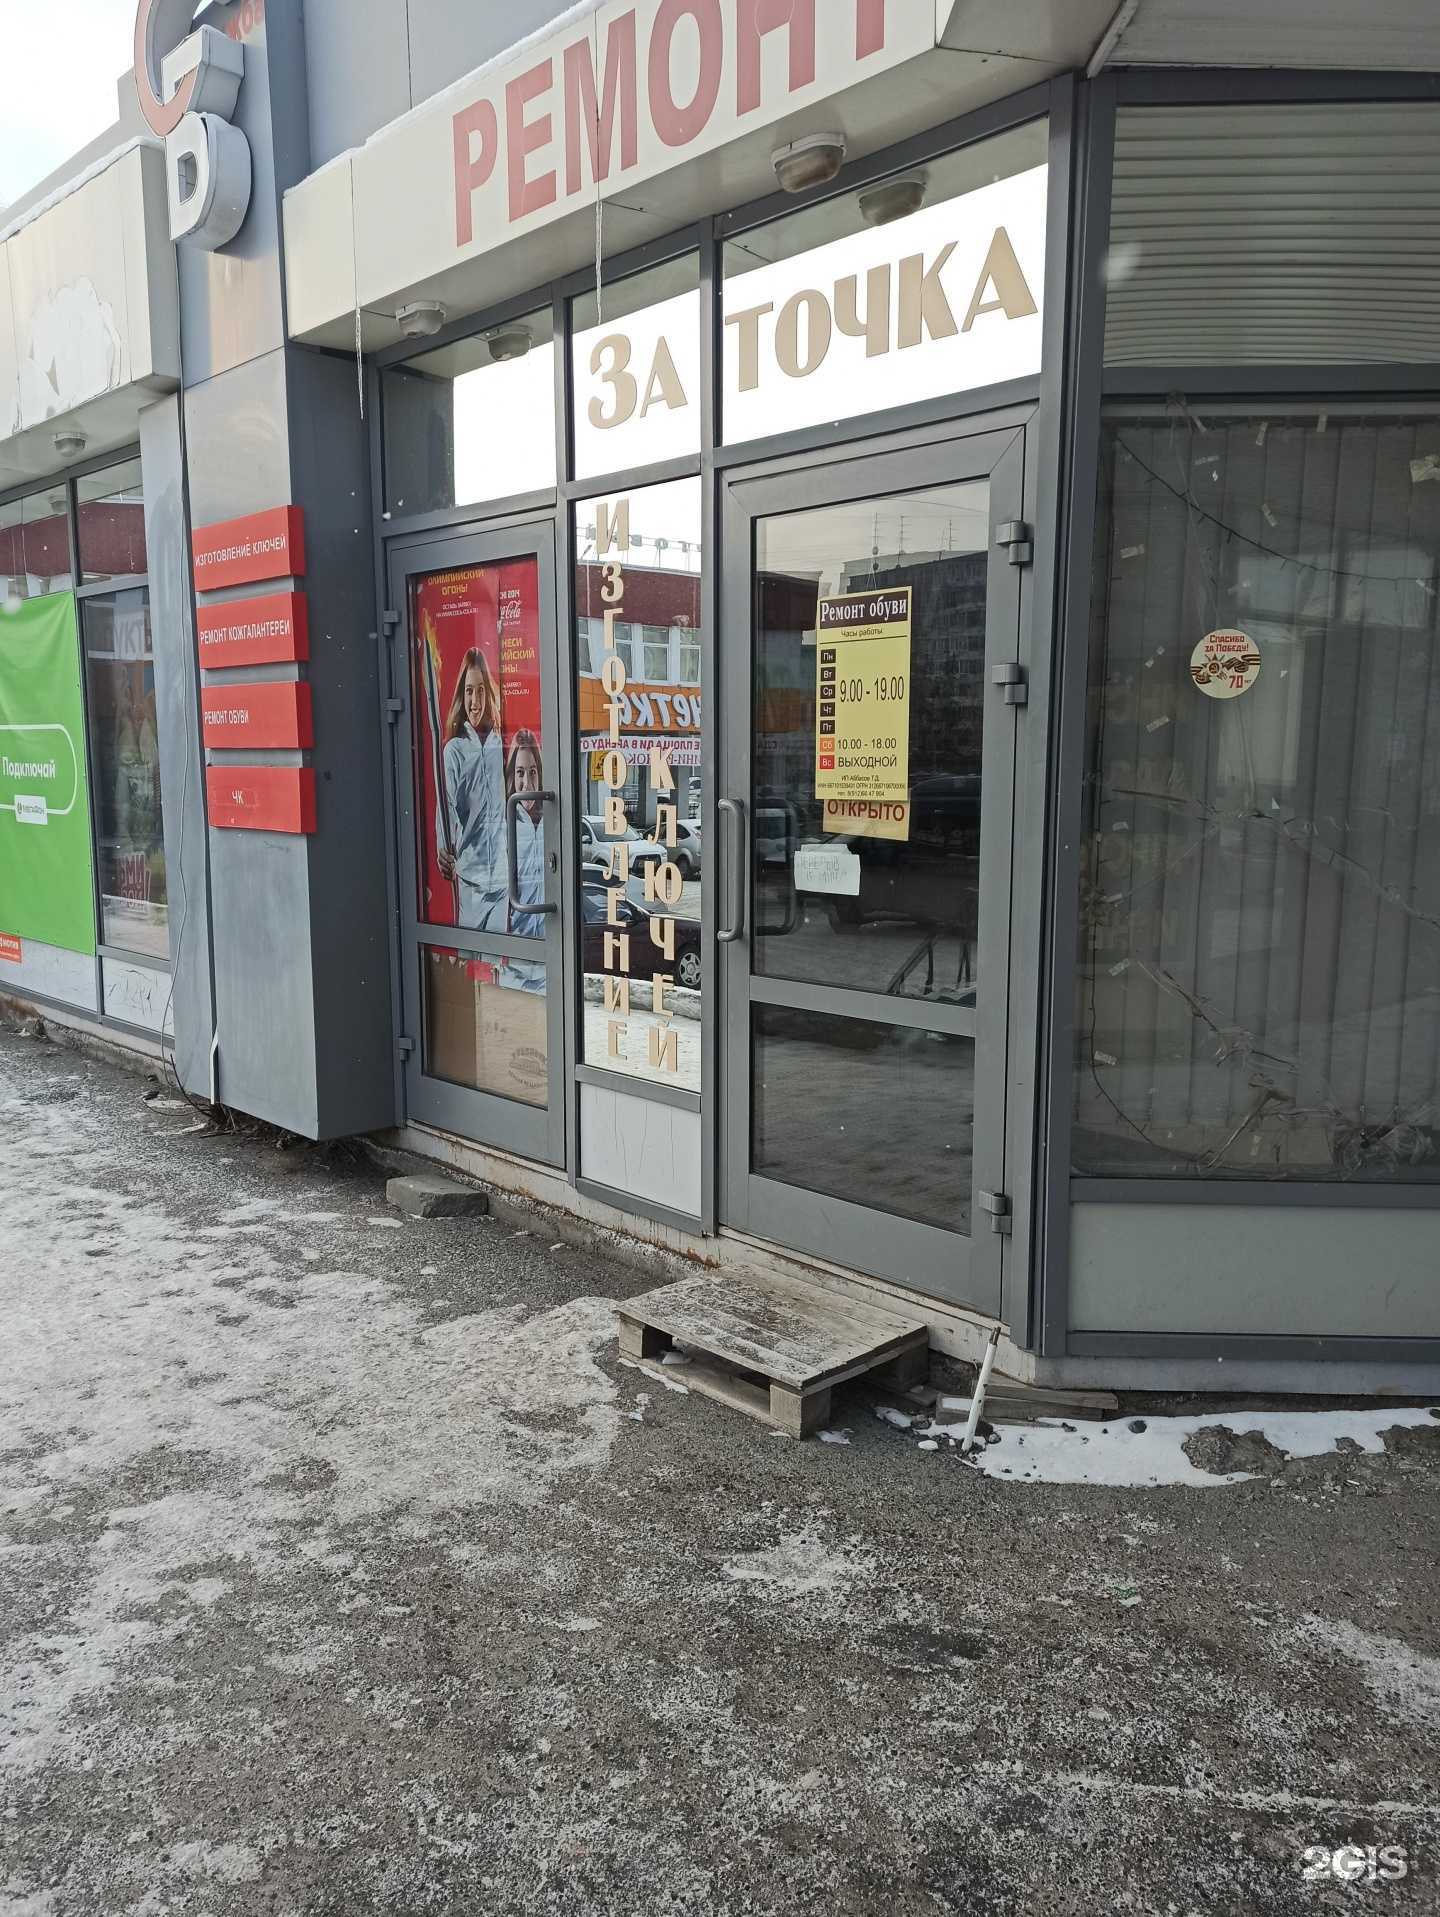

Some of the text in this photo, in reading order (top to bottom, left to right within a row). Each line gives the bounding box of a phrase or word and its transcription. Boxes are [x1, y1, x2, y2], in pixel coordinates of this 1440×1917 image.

[588, 226, 1038, 429] ЗА ТОЧКА
[194, 534, 286, 567] ИЗГОТОВЛЕНИЕ КЛЮЧЕЙ
[821, 596, 906, 622] Ремонт обуви
[200, 620, 290, 645] РЕМОНТ КОЖГАЛАНТЕРЕИ
[841, 628, 883, 638] Часы работы
[823, 652, 833, 660] Пн
[823, 670, 832, 679] Вт
[1229, 675, 1243, 688] 70
[823, 687, 833, 696] Ср
[840, 679, 862, 702] 9.00
[874, 676, 904, 701] 19.00
[204, 709, 249, 725] РЕМОНТ ОБУВИ
[823, 705, 832, 714] Чт
[822, 723, 832, 731] Пт
[823, 740, 832, 749] Сб
[838, 738, 861, 750] 10.00
[872, 738, 896, 749] 18.00
[2, 756, 56, 780] Подключай
[822, 754, 897, 768] Вс ВЫХОДНОЙ
[596, 498, 630, 1061] ИЗГОТОВЛЕНИЕ
[232, 790, 245, 805] ЧК
[827, 799, 905, 821] ОТКРЫТО
[645, 747, 684, 1073] КЛЮЧЕЙ
